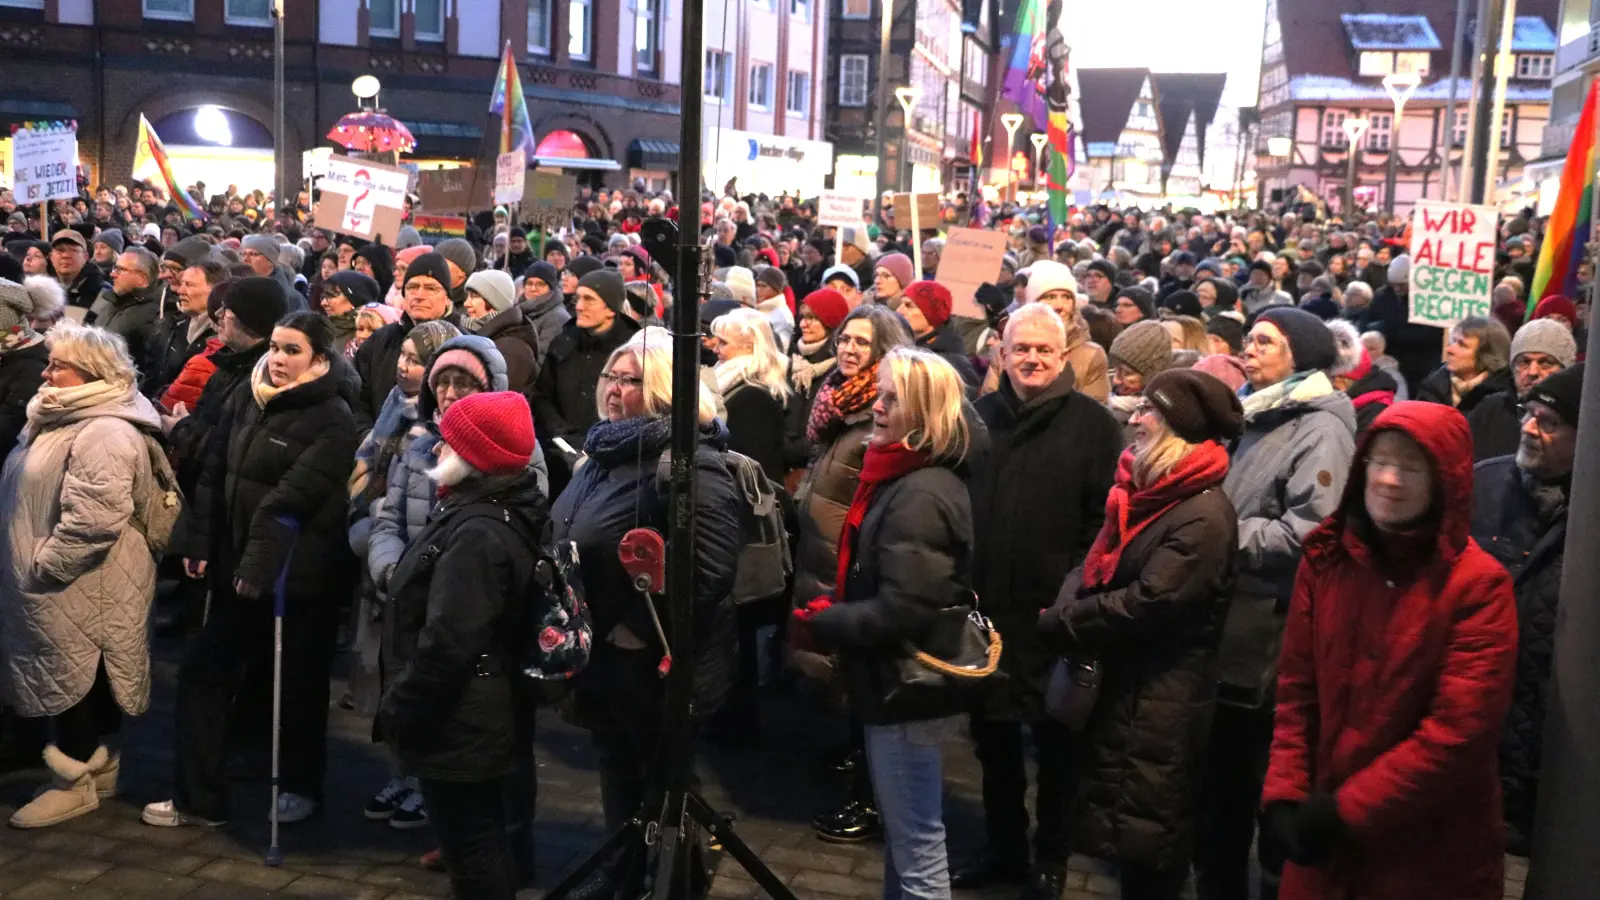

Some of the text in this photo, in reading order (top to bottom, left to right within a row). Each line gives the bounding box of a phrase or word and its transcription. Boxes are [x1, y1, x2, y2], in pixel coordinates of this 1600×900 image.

[14, 162, 67, 183] NIE WIEDER
[27, 178, 75, 199] IST JETZT!
[1423, 207, 1476, 234] WIR
[1414, 238, 1496, 274] ALLE
[1414, 265, 1489, 296] GEGEN
[1413, 293, 1489, 320] RECHTS
